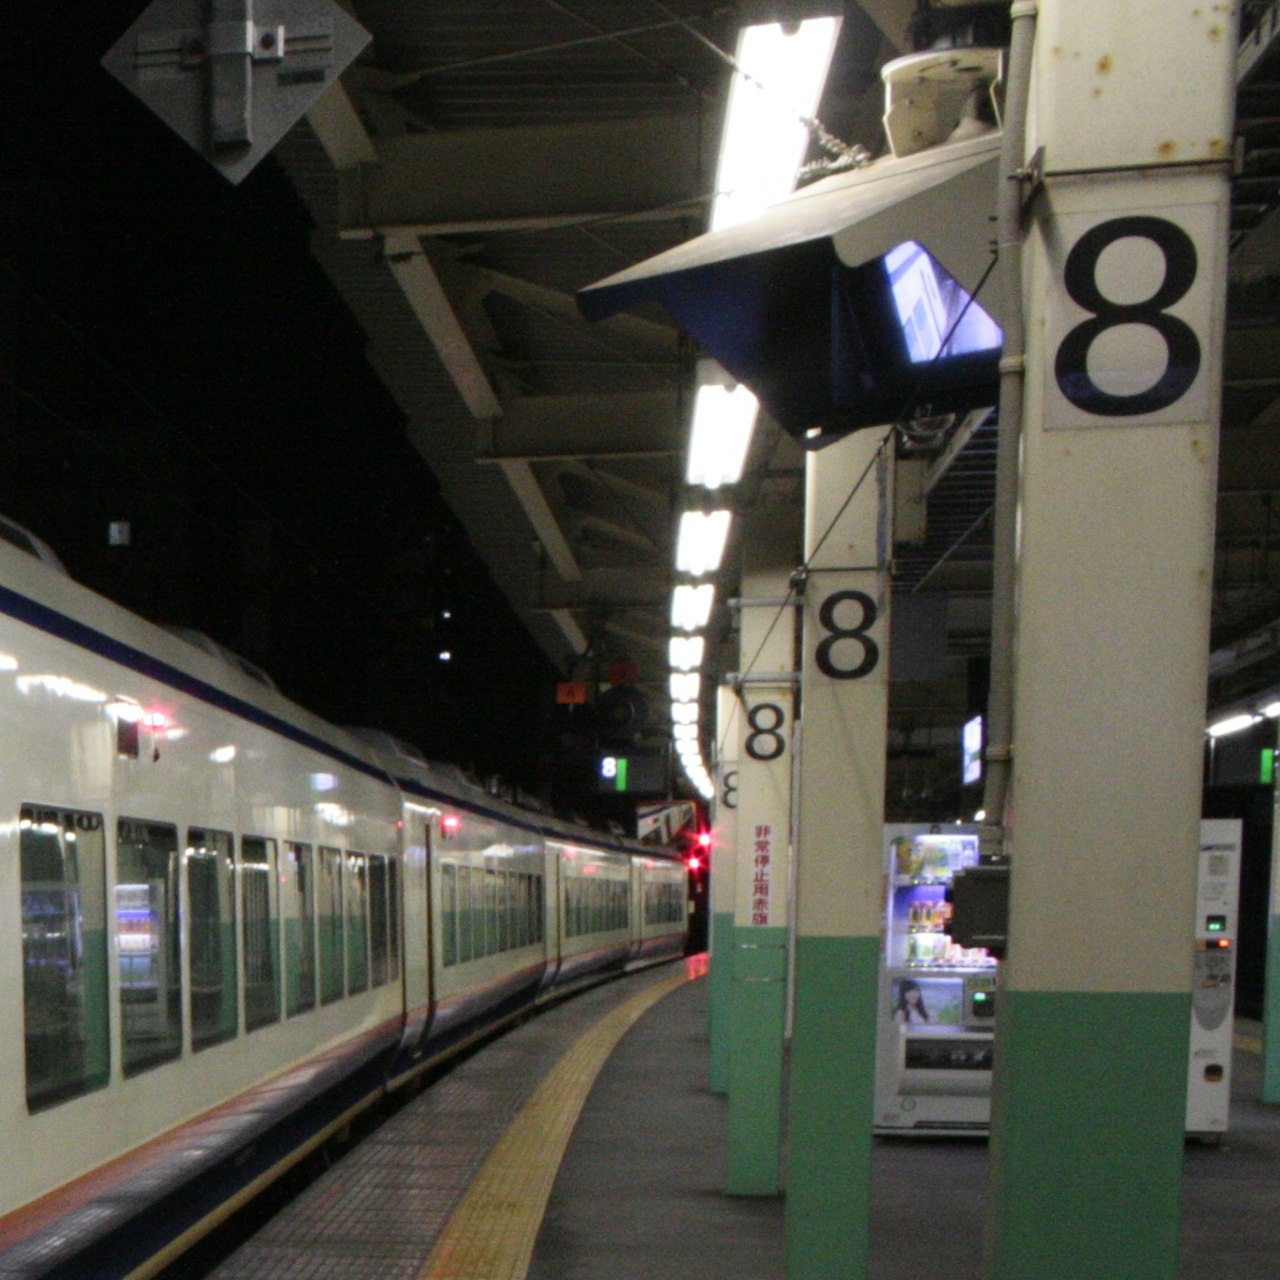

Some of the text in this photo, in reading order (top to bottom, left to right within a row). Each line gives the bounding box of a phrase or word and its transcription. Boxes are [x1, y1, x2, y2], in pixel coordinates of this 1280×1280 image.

[1054, 215, 1201, 417] 8
[815, 590, 879, 680] 8
[599, 757, 617, 778] 8
[745, 703, 785, 761] 8
[751, 825, 771, 926] 非常停止用赤旗
